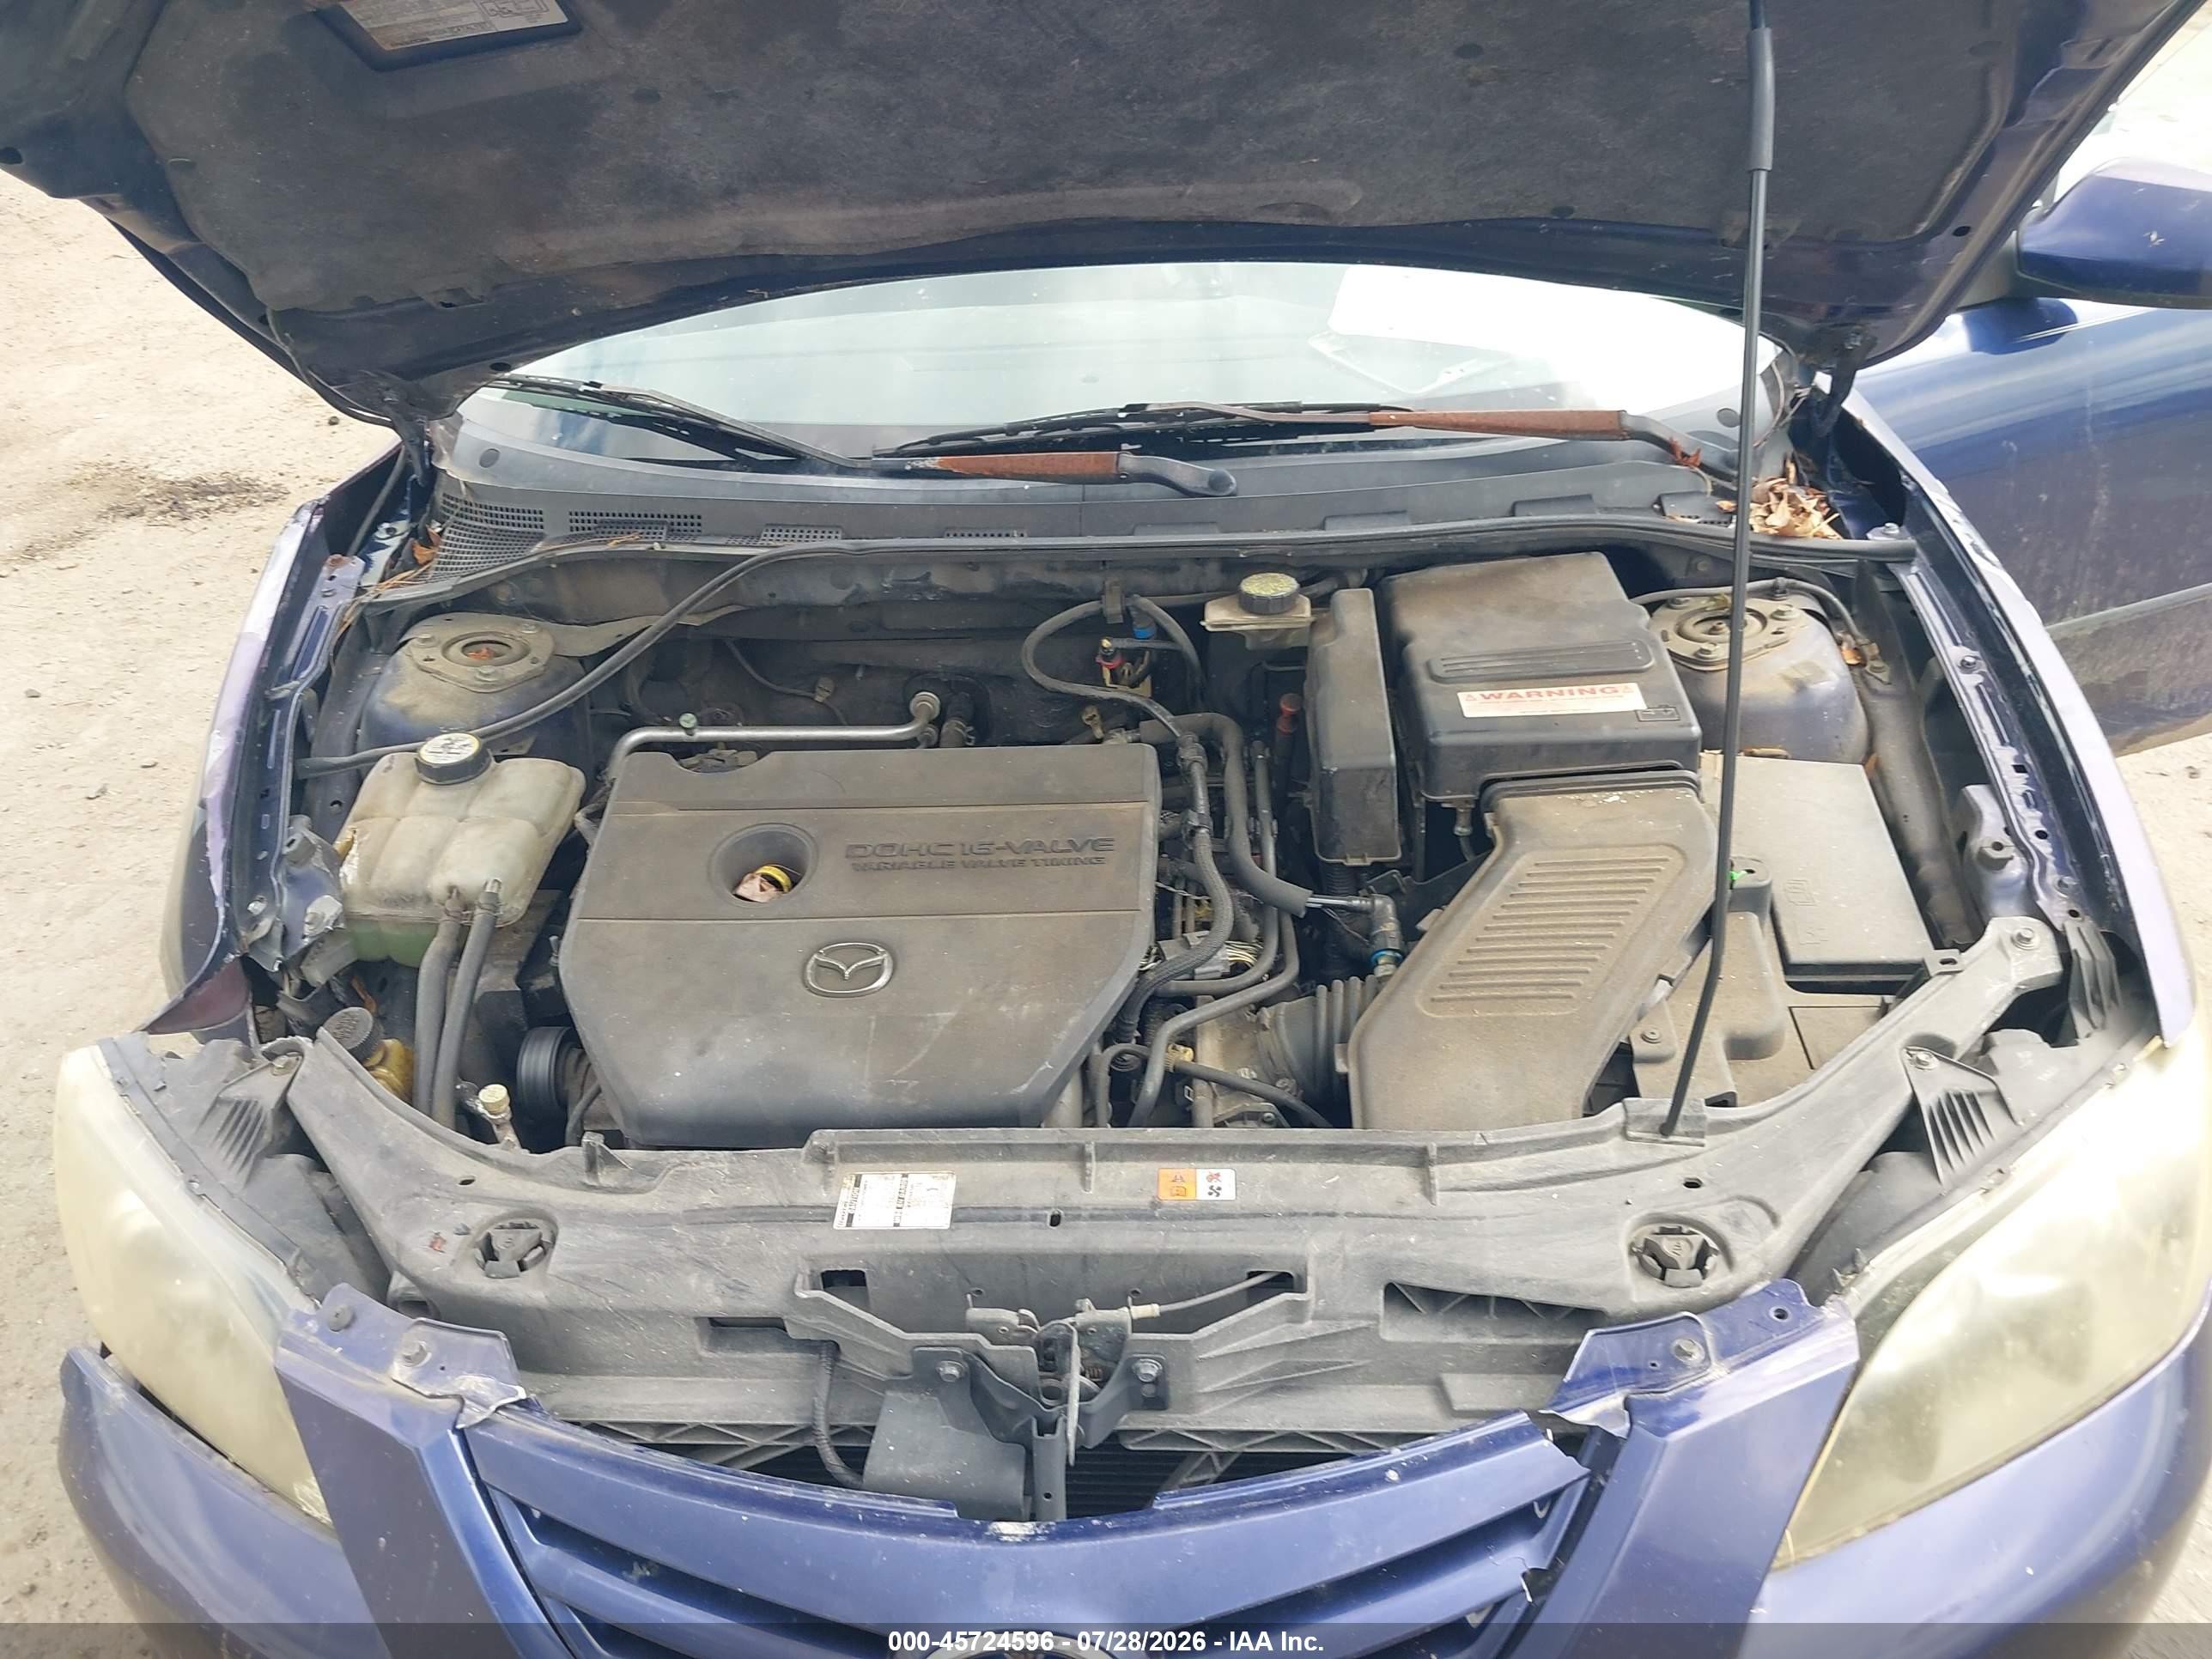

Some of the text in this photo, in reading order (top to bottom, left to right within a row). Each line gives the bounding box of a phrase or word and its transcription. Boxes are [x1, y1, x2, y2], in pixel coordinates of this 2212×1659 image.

[1480, 686, 1620, 701] WARNING
[845, 837, 1115, 859] DOHC 16-VALVE
[851, 856, 1106, 872] VARIABLE VALVE TIMING
